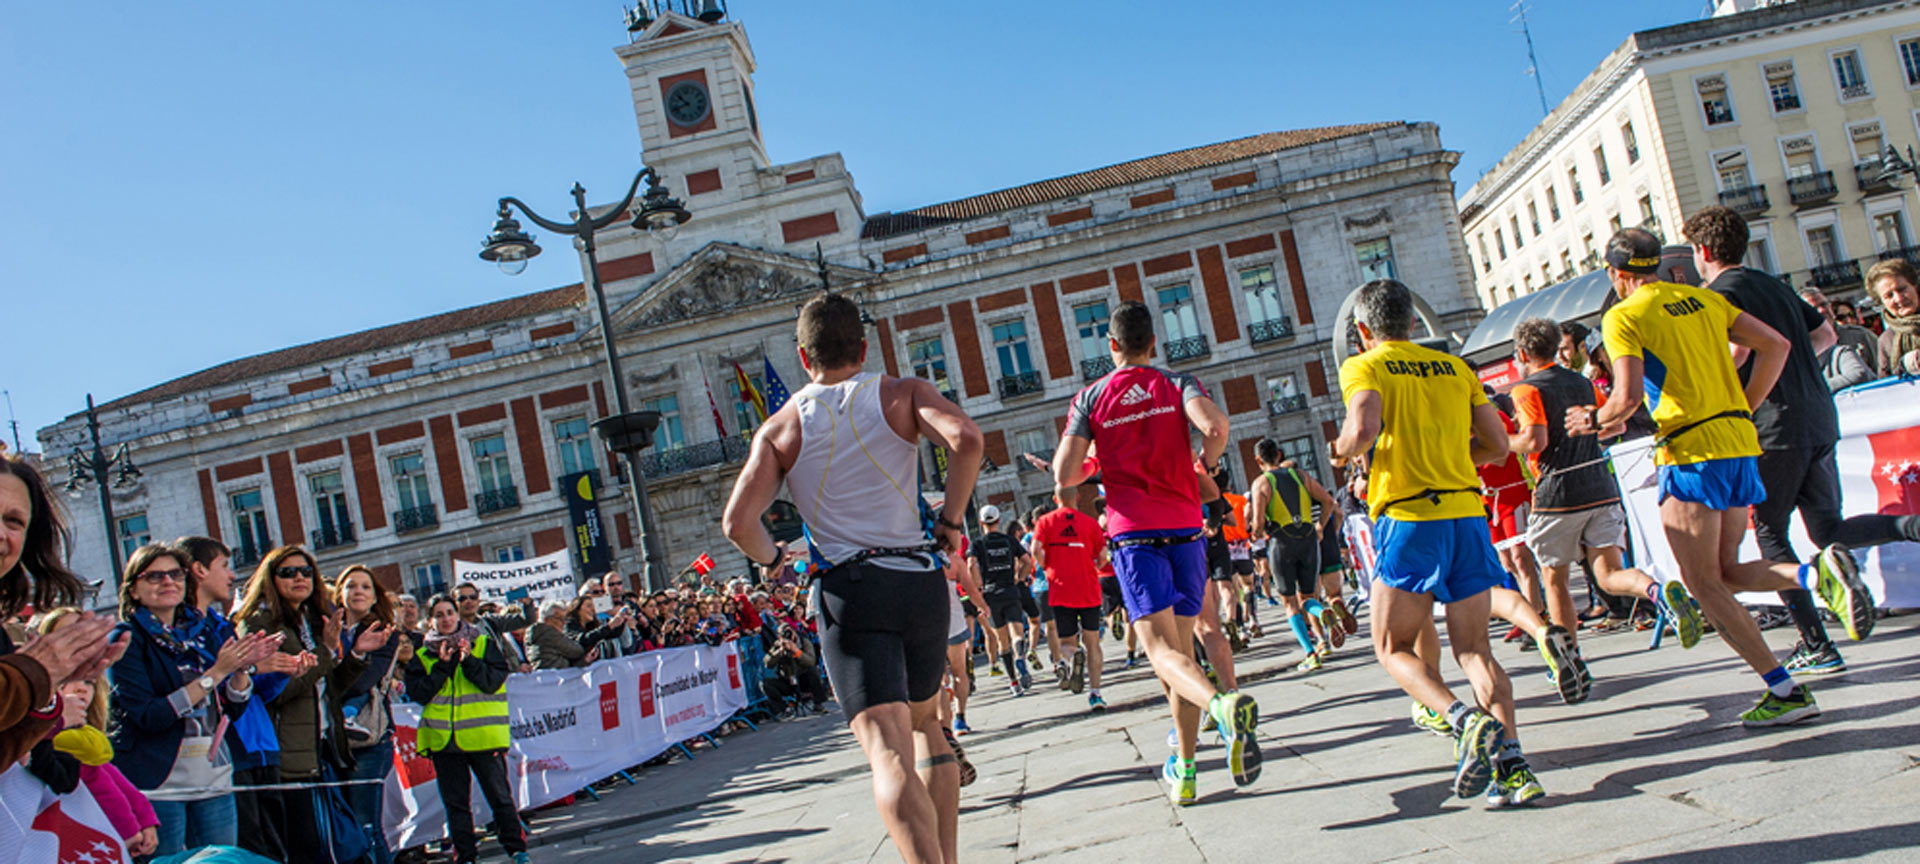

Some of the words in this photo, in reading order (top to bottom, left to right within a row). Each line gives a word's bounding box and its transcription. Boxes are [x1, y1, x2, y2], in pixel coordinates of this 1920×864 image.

[1786, 138, 1811, 149] HOSTAL
[1663, 296, 1704, 316] GUIA
[1385, 360, 1457, 378] GASPAR
[1120, 392, 1152, 405] adidas
[462, 561, 558, 581] CONCENTRATE
[487, 587, 506, 598] EL
[527, 575, 573, 592] MENTO
[532, 713, 545, 736] de
[543, 708, 577, 734] Madrid
